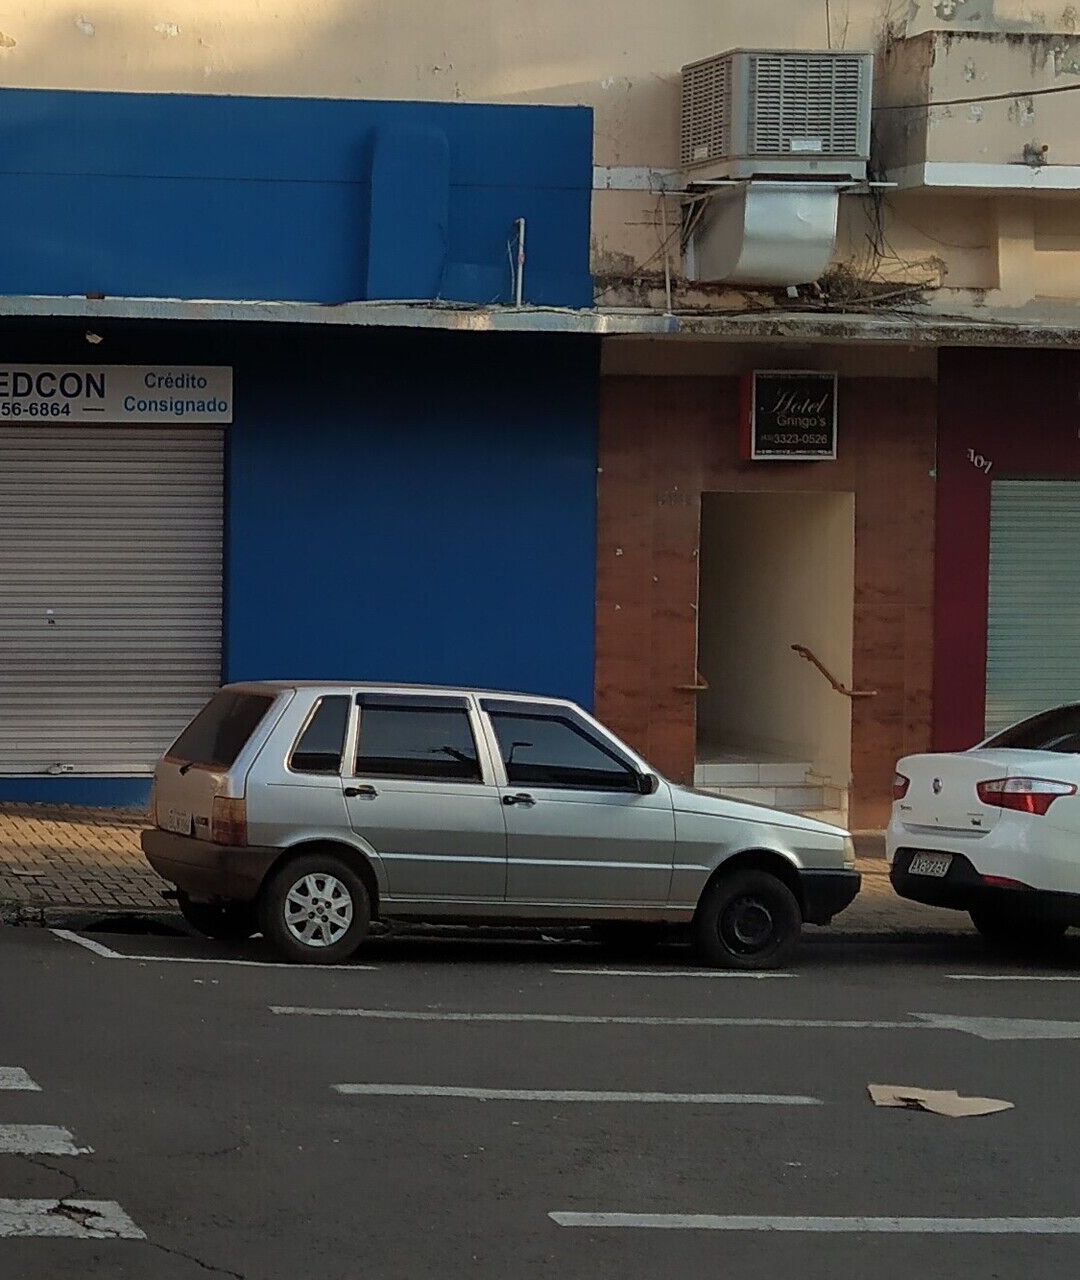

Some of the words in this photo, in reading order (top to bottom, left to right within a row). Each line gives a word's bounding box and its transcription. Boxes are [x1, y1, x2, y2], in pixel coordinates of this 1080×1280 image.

[144, 372, 208, 389] Crédito
[123, 396, 228, 415] Consignado
[765, 390, 829, 413] Hotel
